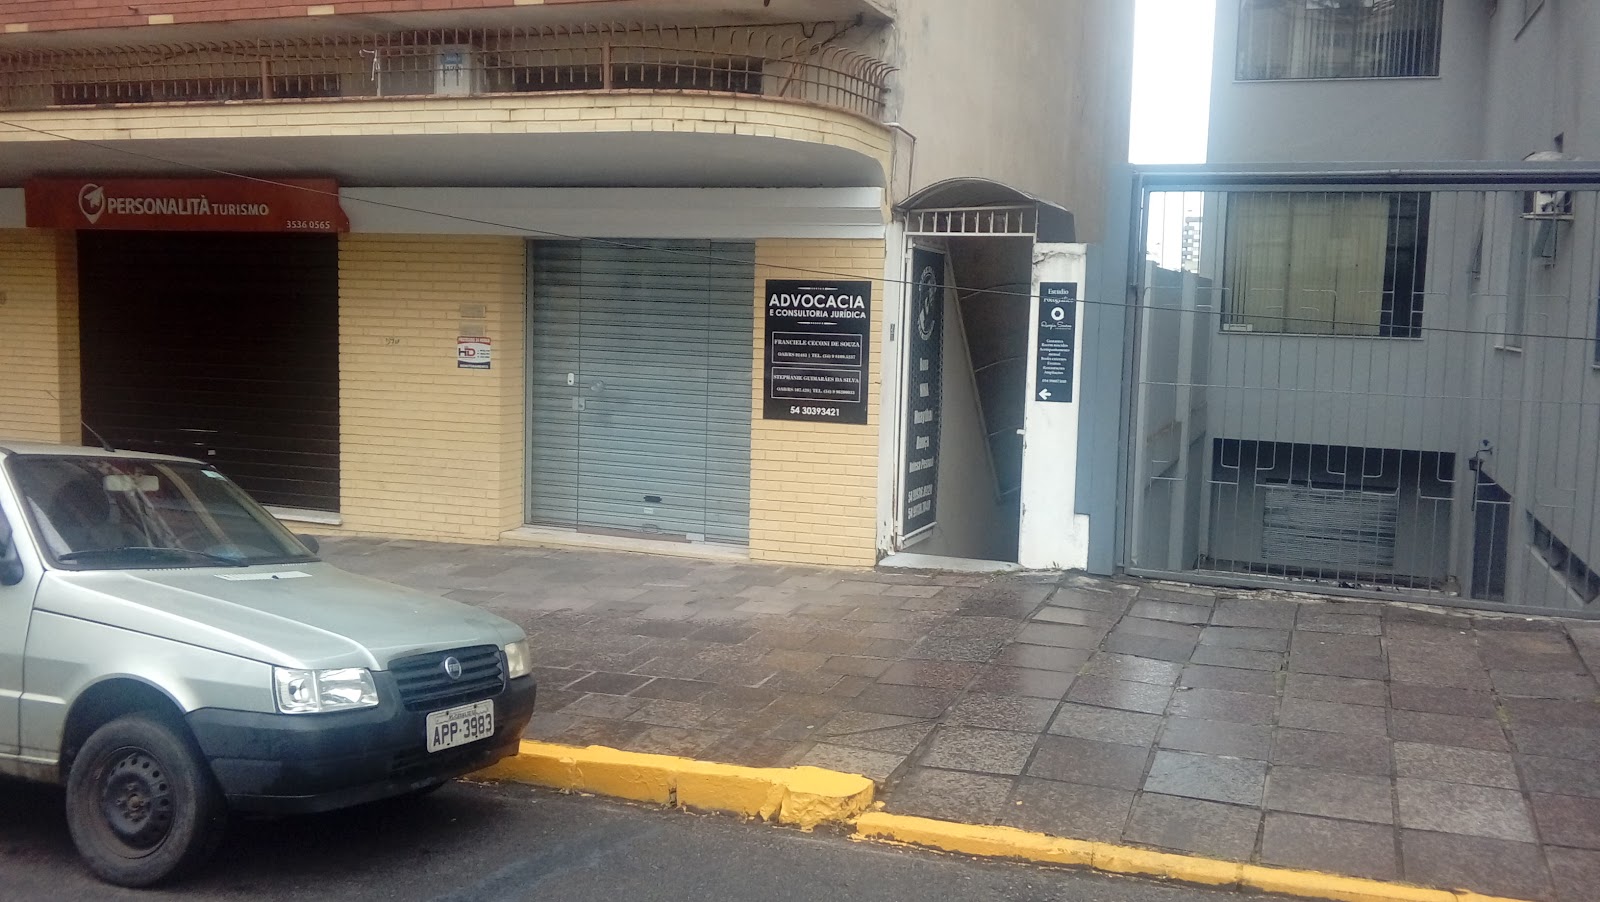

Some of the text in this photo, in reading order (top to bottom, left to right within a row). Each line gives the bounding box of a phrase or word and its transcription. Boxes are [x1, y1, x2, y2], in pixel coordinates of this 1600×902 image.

[107, 194, 270, 216] PERSONALITÀ TURISMO
[286, 220, 331, 229] 3536 0565
[769, 293, 865, 309] ADVOCACIA
[769, 308, 867, 319] E CONSULTORIA JURÍDICA
[774, 338, 807, 346] FRANCIELE
[790, 405, 840, 416] 54 30393421
